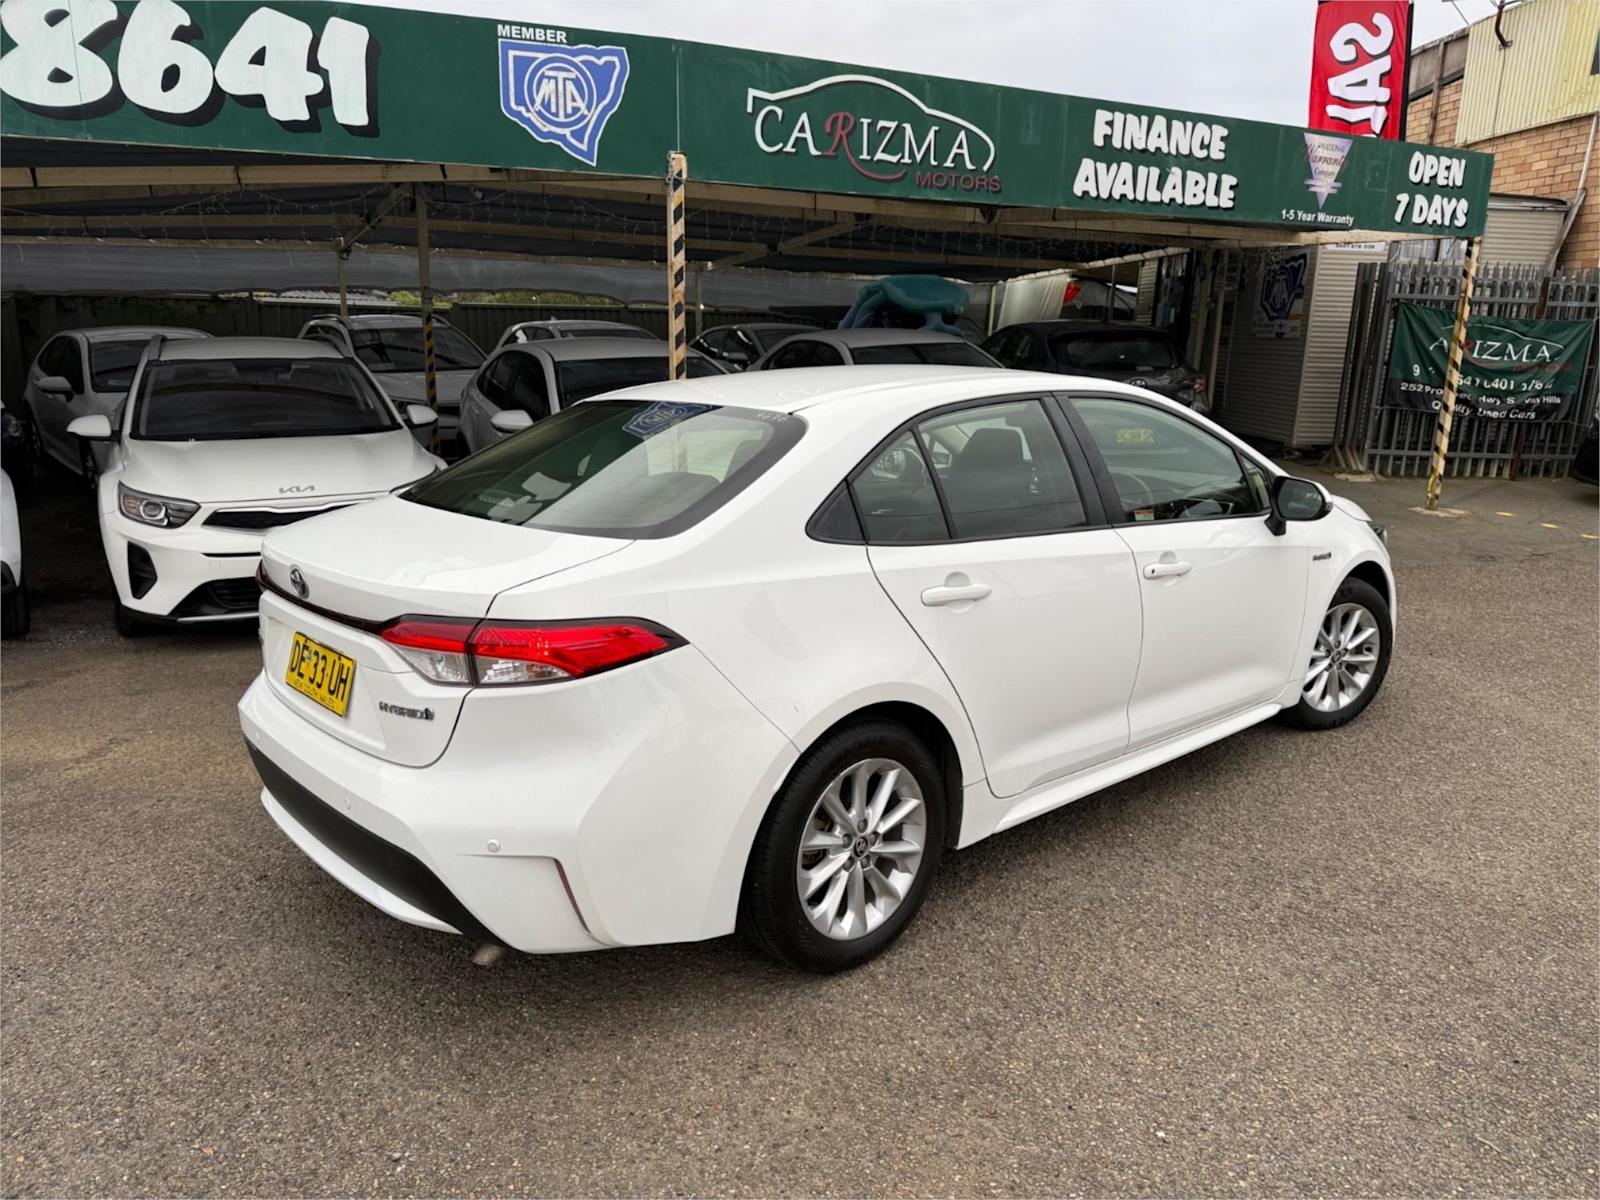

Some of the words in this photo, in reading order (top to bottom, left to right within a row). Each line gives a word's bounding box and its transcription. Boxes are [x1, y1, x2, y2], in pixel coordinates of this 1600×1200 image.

[497, 24, 568, 44] MEMBER
[0, 0, 369, 126] 8641
[532, 69, 590, 121] MTA
[754, 105, 977, 177] CARIZMA
[1093, 109, 1229, 160] FINANCE
[915, 170, 1001, 192] MOTORS
[1072, 157, 1238, 208] AVAILABLE
[1408, 150, 1467, 187] OPEN
[1281, 209, 1295, 221] 1-5
[1297, 210, 1316, 223] Year
[1317, 211, 1355, 227] Warranty
[1394, 192, 1410, 223] 7
[1412, 193, 1469, 228] DAYS
[1509, 409, 1536, 420] Cars
[1542, 395, 1561, 405] Hills
